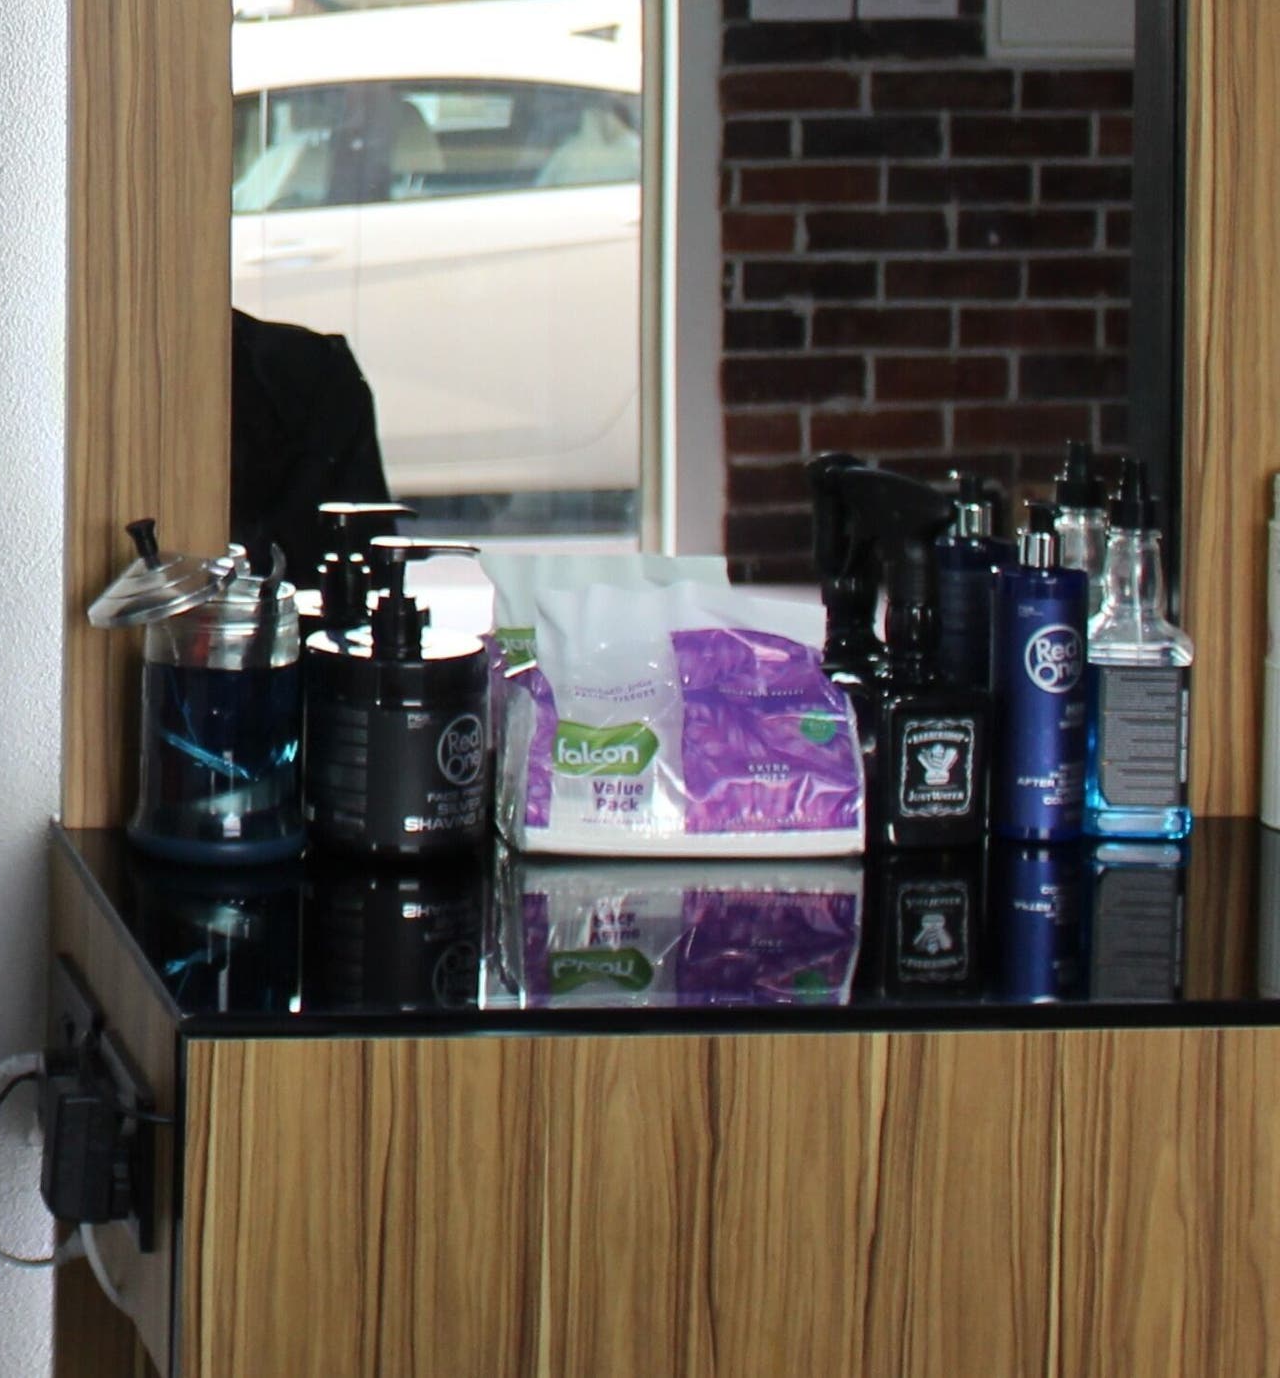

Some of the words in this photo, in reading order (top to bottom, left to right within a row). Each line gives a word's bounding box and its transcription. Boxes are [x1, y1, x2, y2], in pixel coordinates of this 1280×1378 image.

[1035, 638, 1078, 663] Red
[448, 730, 480, 755] Red
[557, 737, 639, 764] falcon
[446, 750, 481, 777] One
[748, 764, 790, 772] EXTRA
[593, 781, 644, 796] Value
[596, 797, 639, 812] Pack
